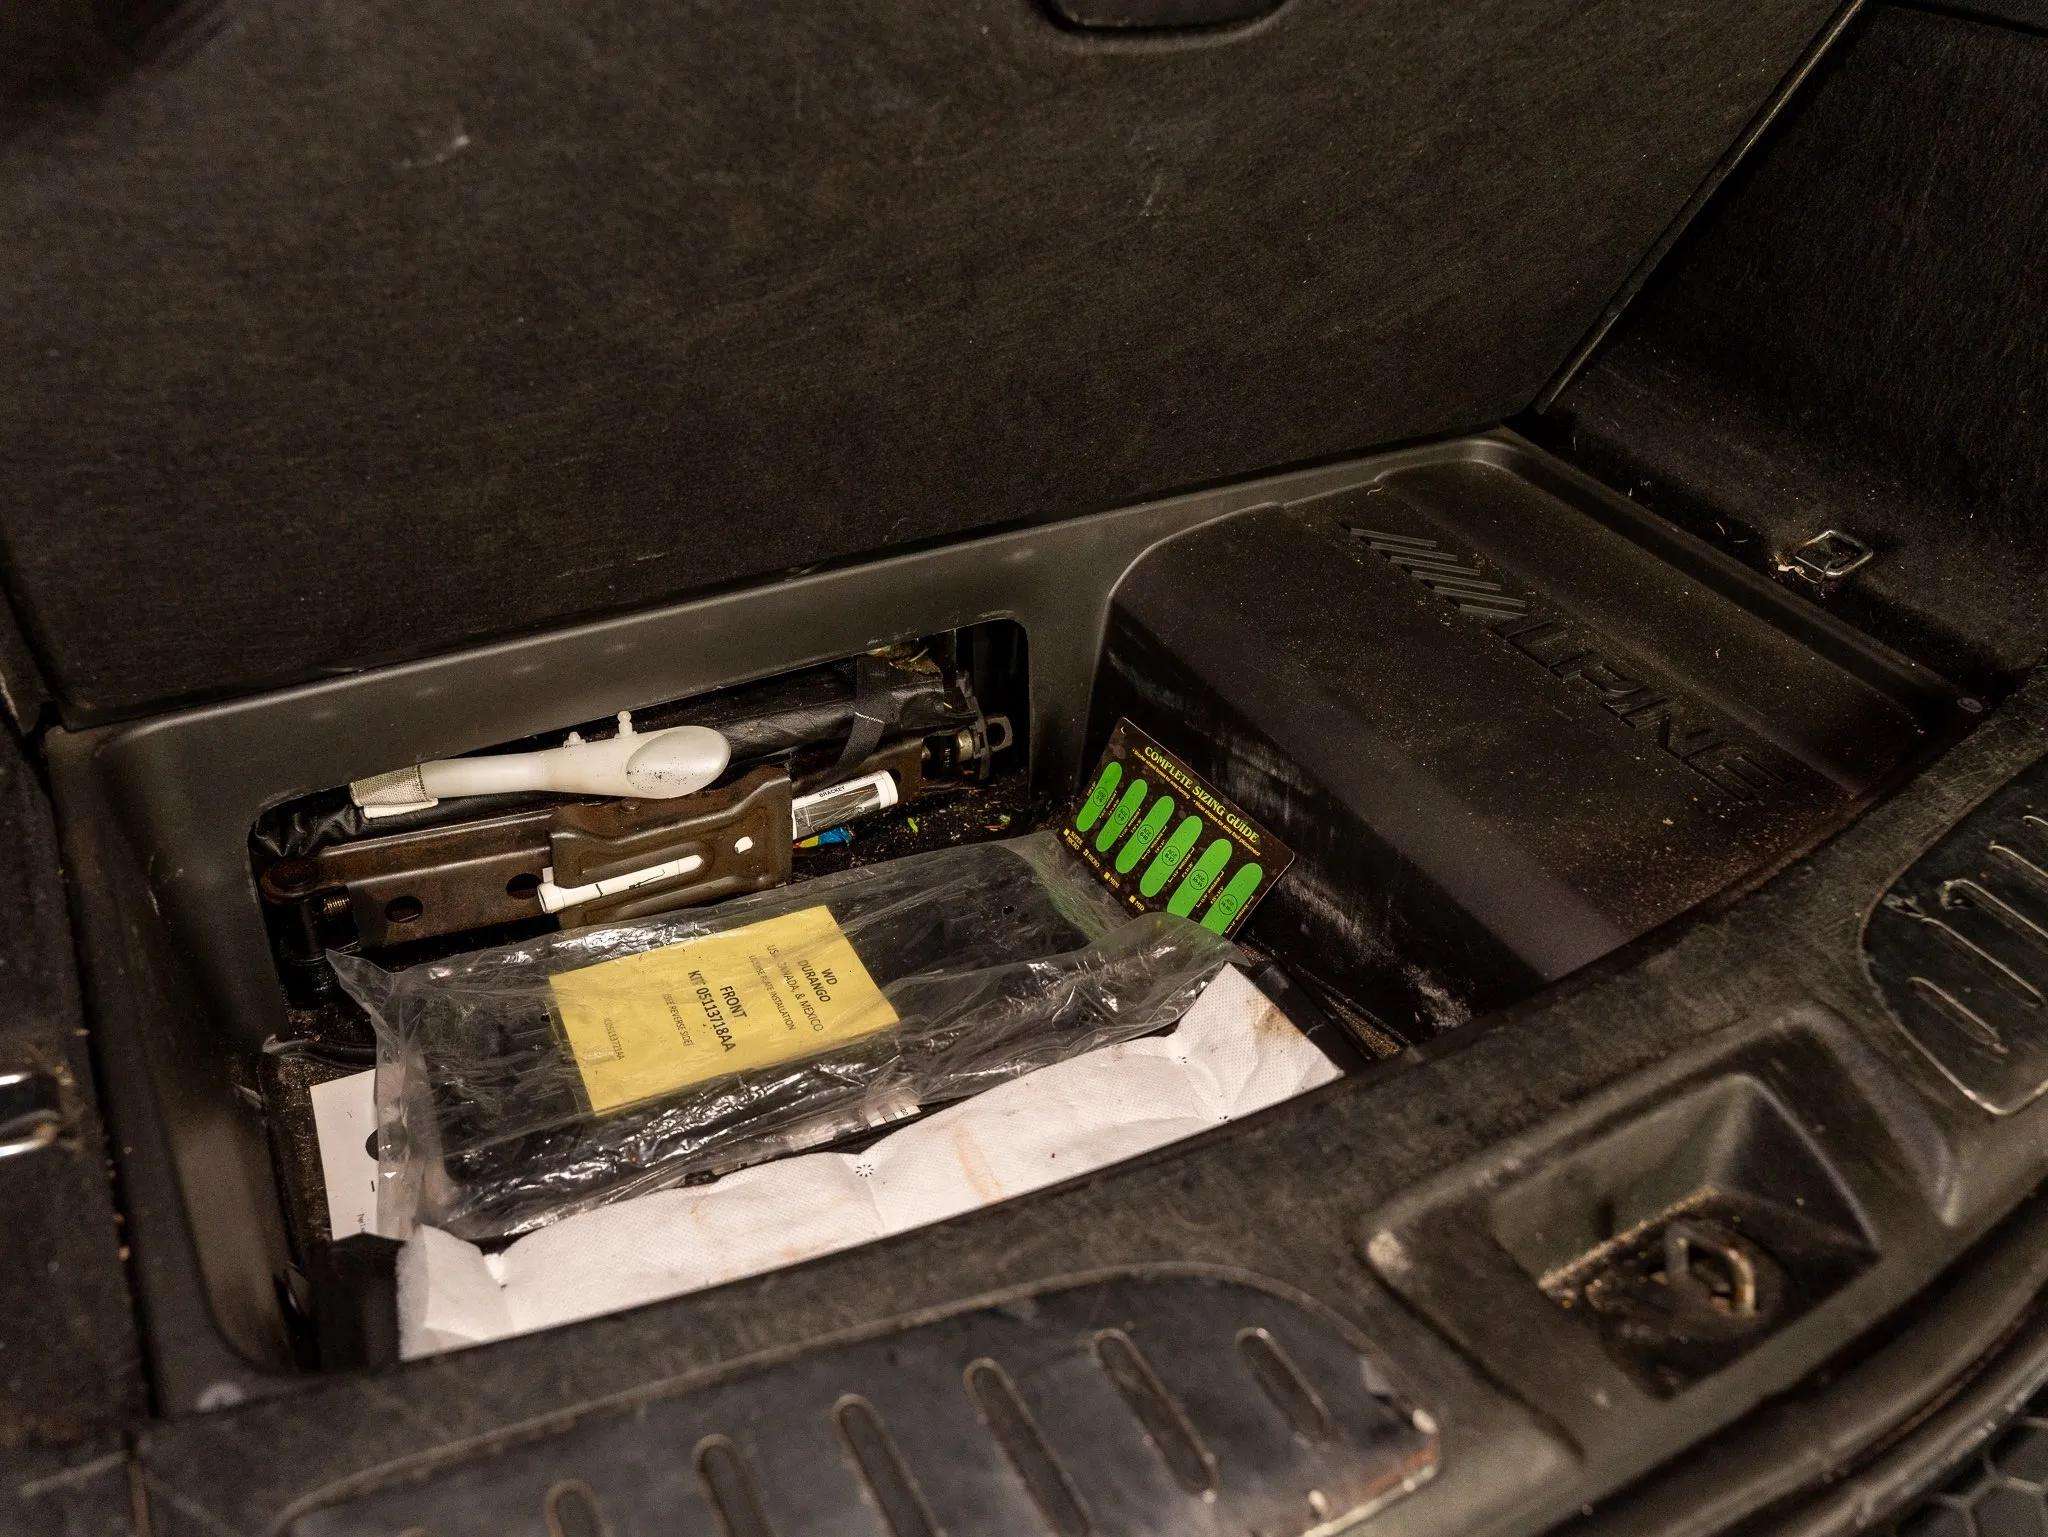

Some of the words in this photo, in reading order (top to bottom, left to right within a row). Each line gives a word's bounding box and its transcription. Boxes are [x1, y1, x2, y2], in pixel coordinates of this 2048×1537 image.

[818, 785, 845, 798] BRACKET
[1142, 745, 1194, 789] COMPLETE
[1190, 784, 1227, 817] SIZING
[1223, 811, 1260, 843] GUIDE
[797, 958, 831, 1004] DURANGO
[820, 967, 838, 986] WD
[718, 983, 747, 1020] FRONT
[793, 991, 805, 1000] &
[695, 985, 737, 1053] 05113718AA
[798, 998, 824, 1032] MEXICO
